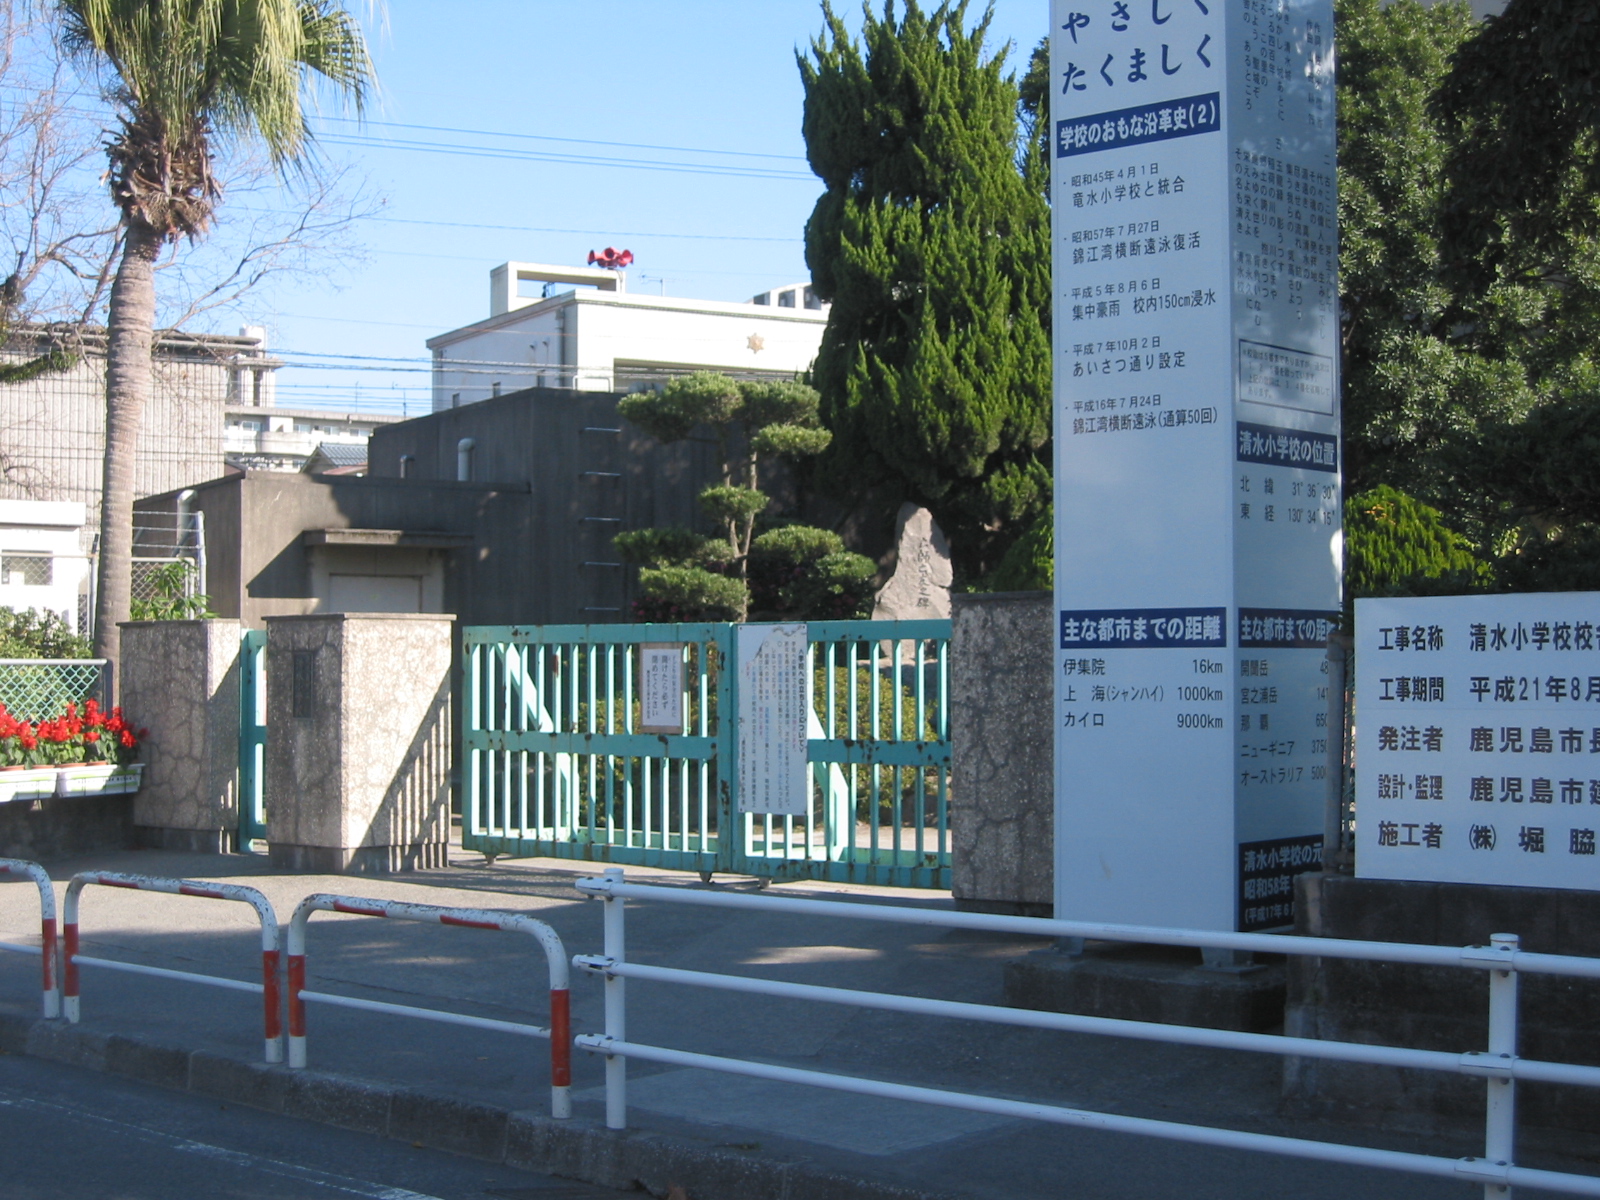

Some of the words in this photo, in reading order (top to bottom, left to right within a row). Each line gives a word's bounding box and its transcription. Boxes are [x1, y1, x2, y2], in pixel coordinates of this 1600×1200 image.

[1062, 33, 1212, 95] たくましく
[1072, 175, 1186, 209] 竜水小学校と統合
[1072, 231, 1201, 265] 錦江湾横断遠泳復活
[1072, 298, 1121, 321] 集中豪雨
[1132, 288, 1217, 315] 校内150cm浸水
[1072, 350, 1187, 378] あいさつ通り設定
[1239, 429, 1335, 466] 清水小学校の位置
[1064, 615, 1221, 642] 主な都市までの距離
[1378, 624, 1444, 651] 工事名称
[1469, 620, 1600, 652] 清水小学校校
[1063, 658, 1106, 676] 伊集院
[1192, 658, 1223, 674] 16km
[1177, 686, 1223, 701] 1000km
[1378, 676, 1445, 703] 工事期間
[1063, 711, 1105, 728] カイロ
[1177, 713, 1223, 729] 9000km
[1240, 739, 1295, 759] ニューギニア
[1378, 725, 1444, 753] 発注者
[1240, 766, 1304, 787] オーストラリア
[1378, 773, 1444, 801] 設計・監理
[1377, 820, 1444, 849] 施工者
